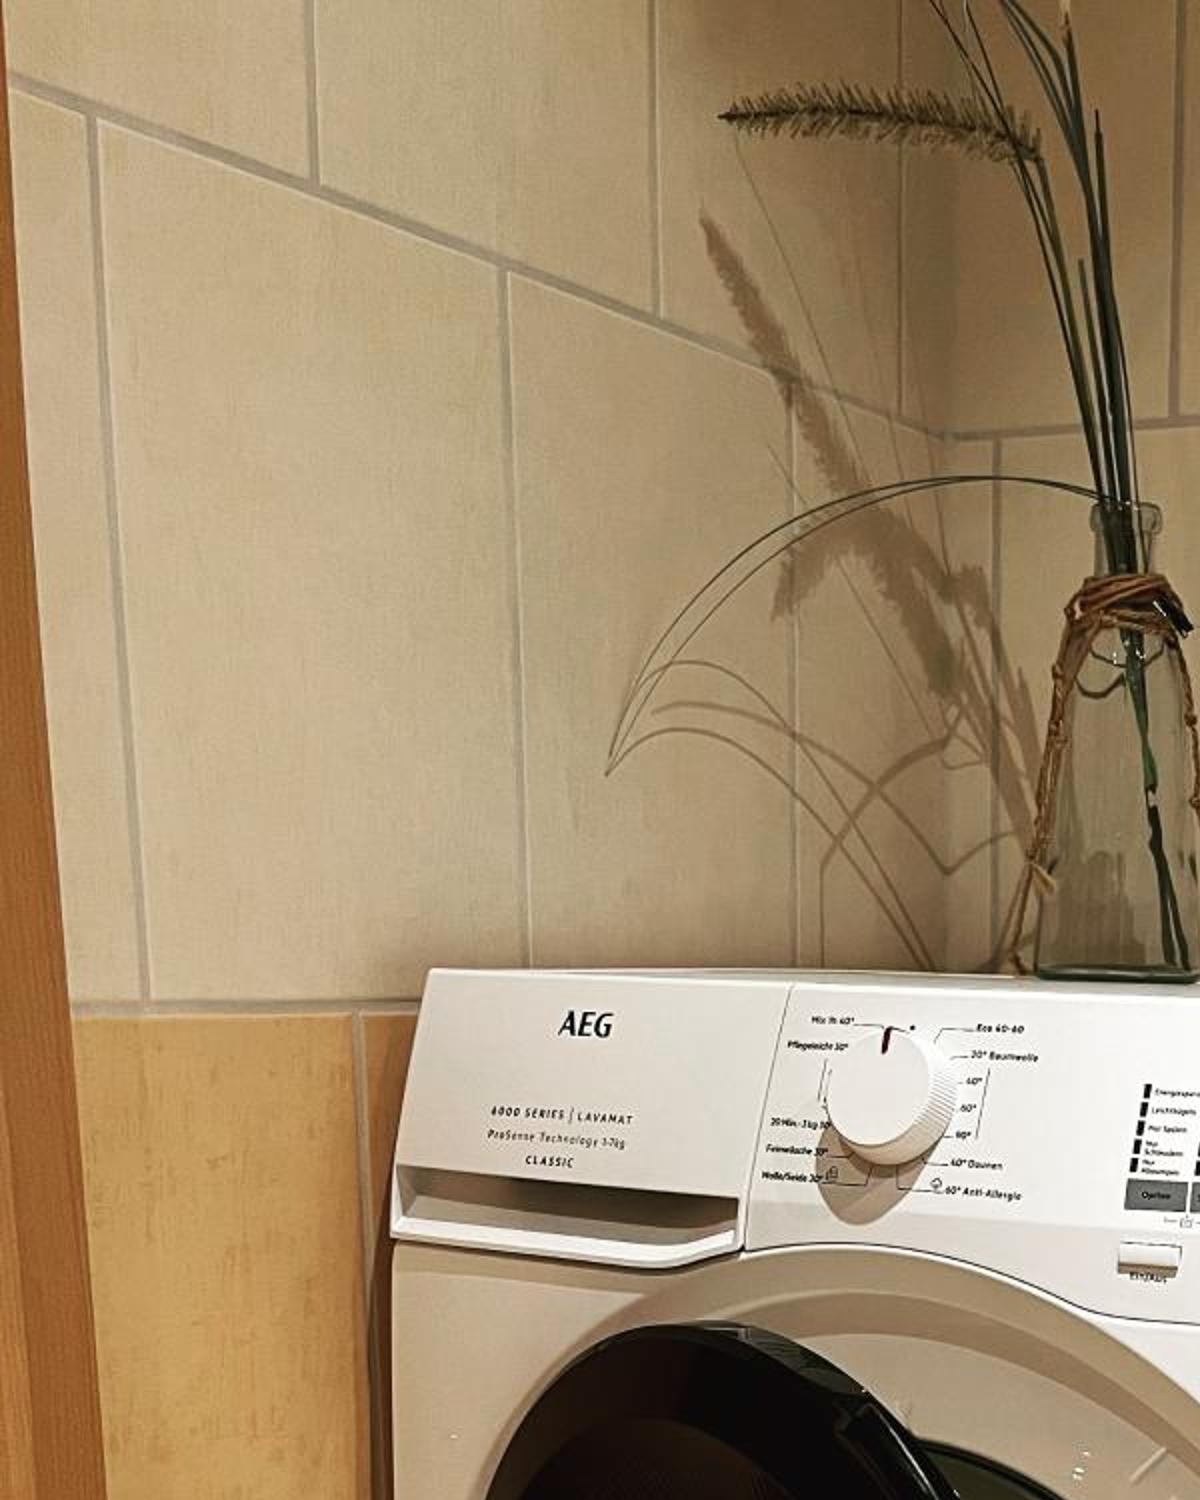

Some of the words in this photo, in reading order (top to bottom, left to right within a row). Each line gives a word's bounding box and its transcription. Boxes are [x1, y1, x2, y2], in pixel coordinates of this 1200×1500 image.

[558, 1010, 614, 1039] AEG
[977, 1023, 993, 1033] Eco
[787, 1040, 833, 1052] Pflegeleicht
[988, 1051, 1039, 1063] Baumwolle
[490, 1105, 521, 1118] 6000
[524, 1107, 565, 1120] SERIES
[577, 1111, 634, 1125] LAVAMAT
[486, 1128, 535, 1143] ProSense
[538, 1131, 599, 1149] Technology
[525, 1154, 575, 1169] CLASSIC
[967, 1159, 1003, 1171] Daunen
